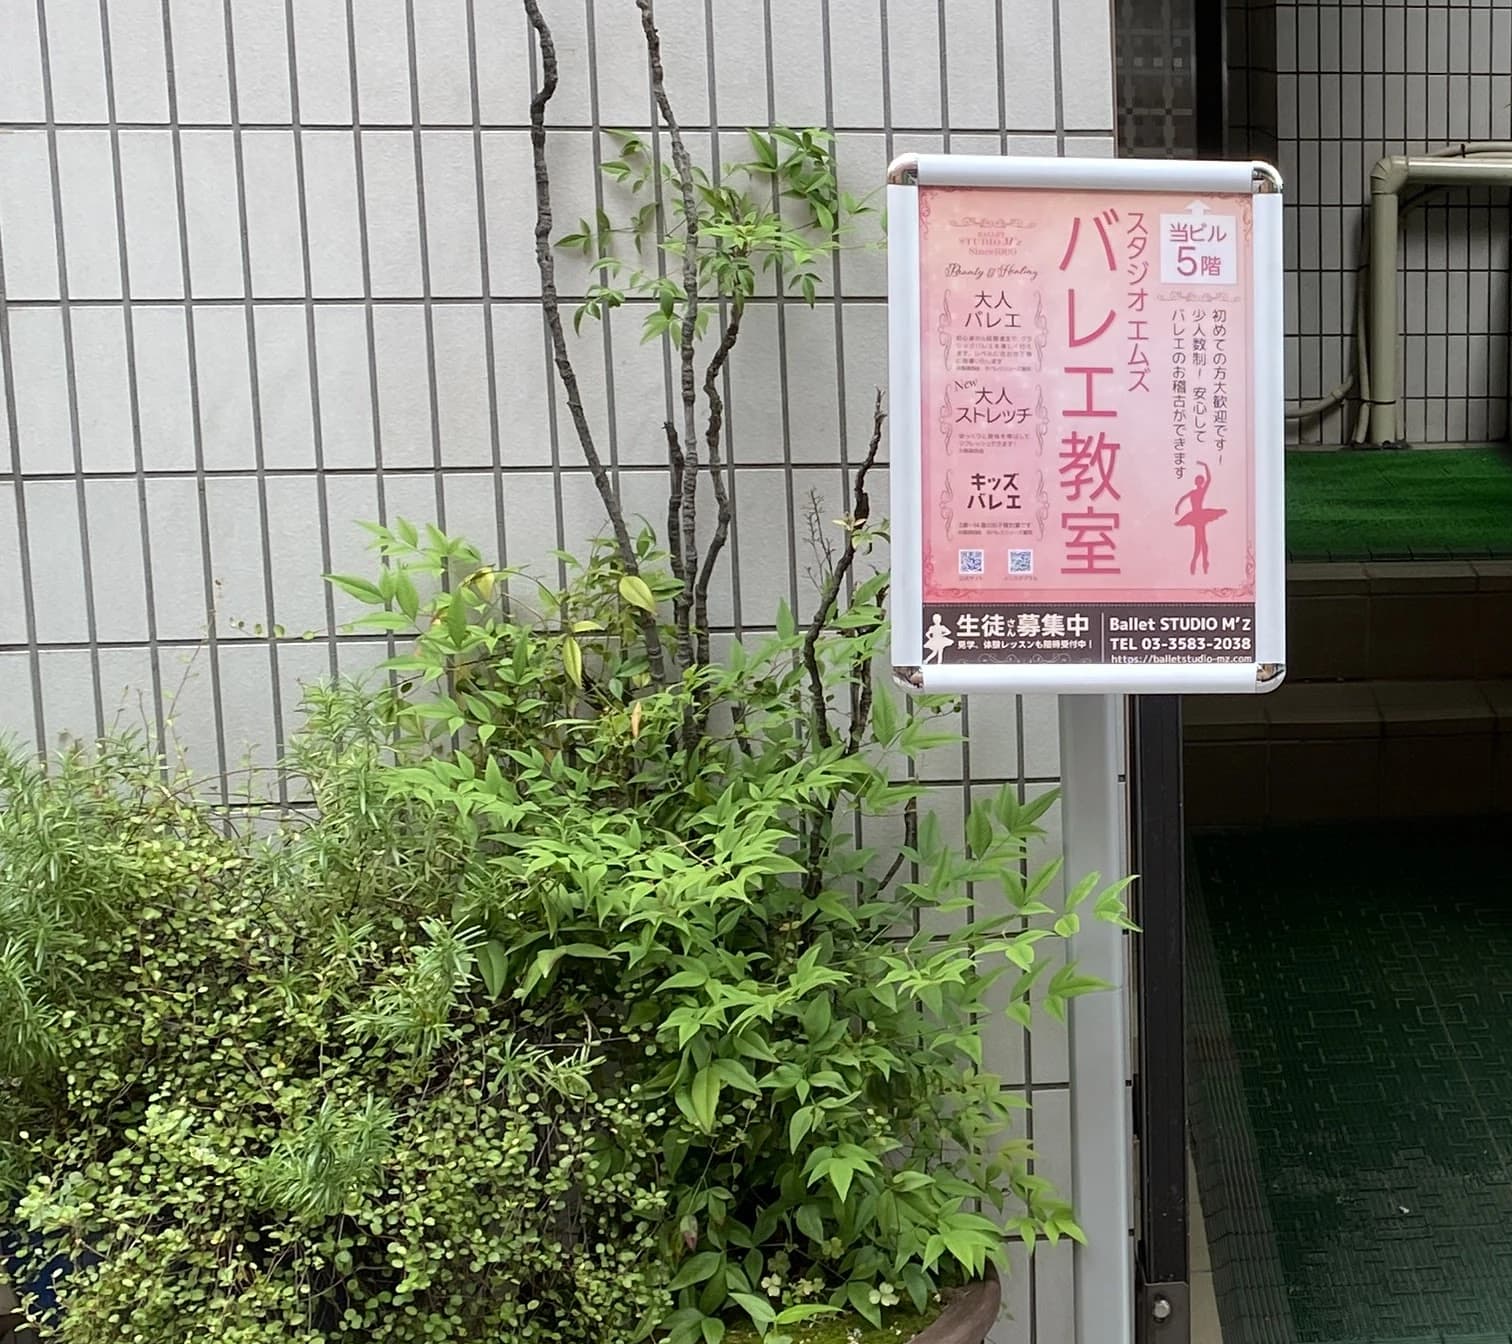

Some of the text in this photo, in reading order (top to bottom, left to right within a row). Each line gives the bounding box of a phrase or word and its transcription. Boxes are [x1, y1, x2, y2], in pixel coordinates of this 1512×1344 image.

[1169, 222, 1228, 244] 当ビル
[1127, 212, 1150, 313] スタジオ
[1177, 245, 1222, 277] 5階
[975, 290, 1013, 310] 大人
[975, 386, 1014, 406] 大人
[1058, 207, 1122, 575] バレエ教室
[1172, 309, 1187, 480] バレエのお稽古ができます
[955, 406, 1033, 425] ストレッチ
[970, 472, 1020, 492] キッズ
[966, 493, 1022, 511] バレエ
[1109, 617, 1156, 632] Ballet
[1160, 617, 1218, 632] STUDIO
[1110, 637, 1252, 651] TEL 03-3583-2038
[1111, 654, 1253, 664] https://balletstudio-mz.com
